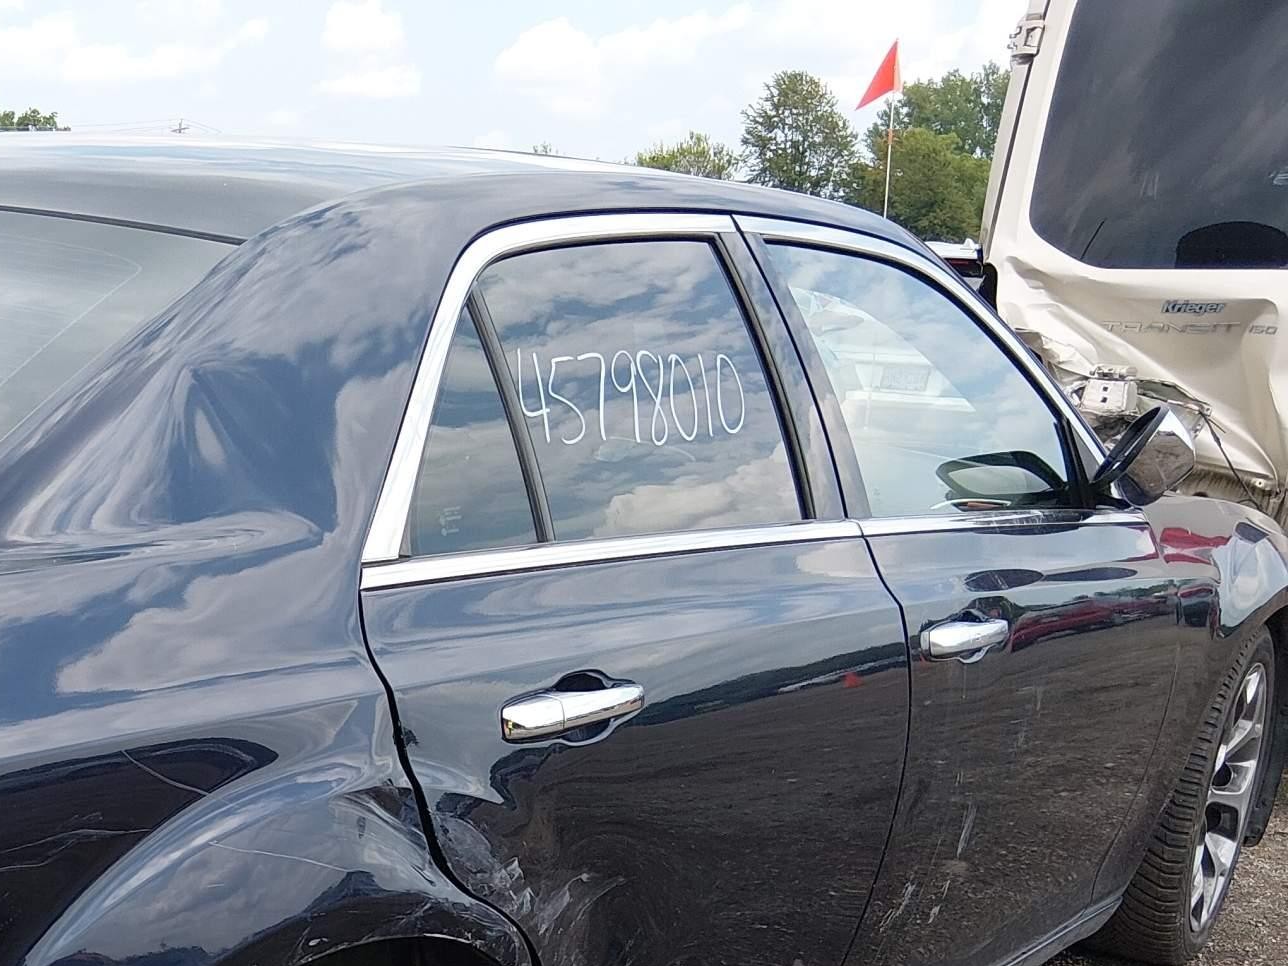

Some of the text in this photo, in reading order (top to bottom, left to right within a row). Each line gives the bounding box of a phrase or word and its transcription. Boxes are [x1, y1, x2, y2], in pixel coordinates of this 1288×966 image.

[1162, 300, 1226, 317] Krieger
[1102, 321, 1241, 335] TRANSIT
[517, 348, 746, 446] 45798010
